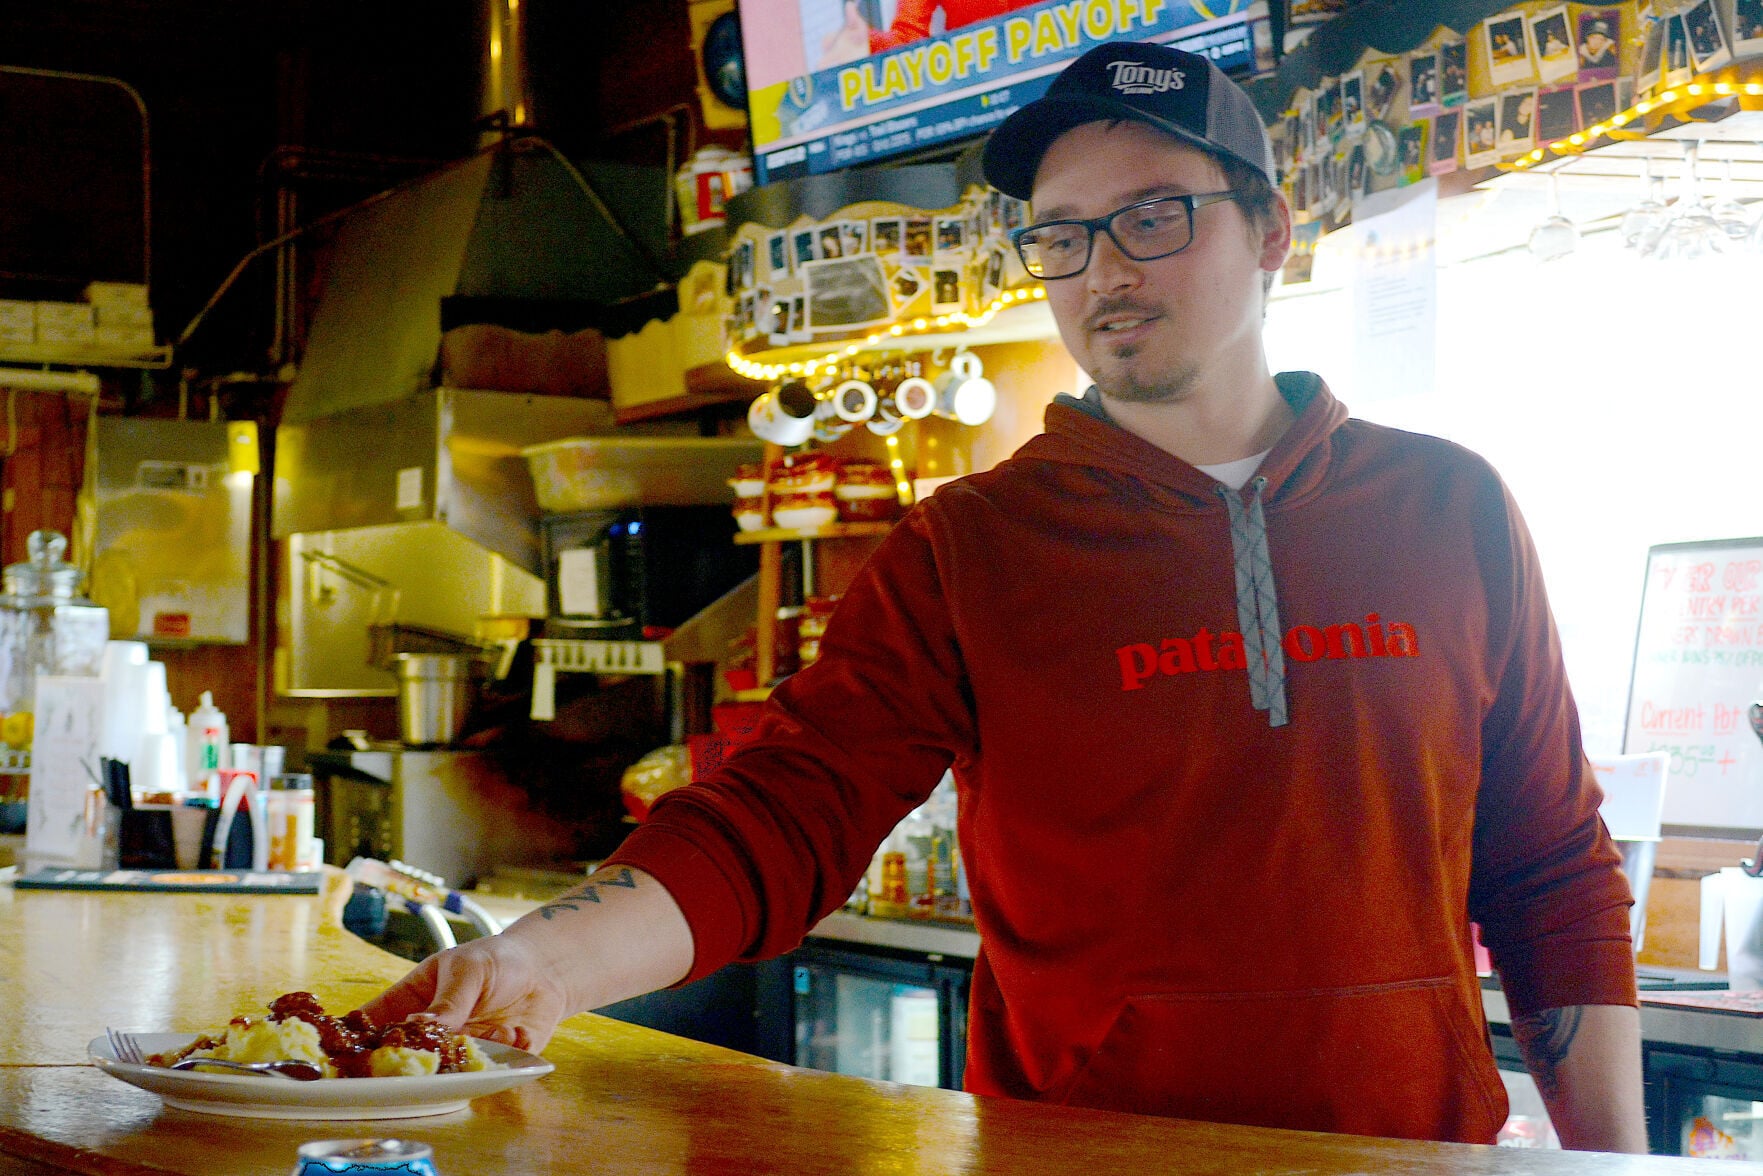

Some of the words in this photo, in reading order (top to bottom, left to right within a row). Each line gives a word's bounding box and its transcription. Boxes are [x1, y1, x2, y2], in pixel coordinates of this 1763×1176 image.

[838, 25, 999, 111] PLAYOFF
[1004, 0, 1164, 64] PAYOFF
[1105, 60, 1187, 93] Tony's
[1115, 612, 1420, 691] pataonia
[1641, 700, 1706, 729] Current
[1713, 702, 1742, 730] Pot
